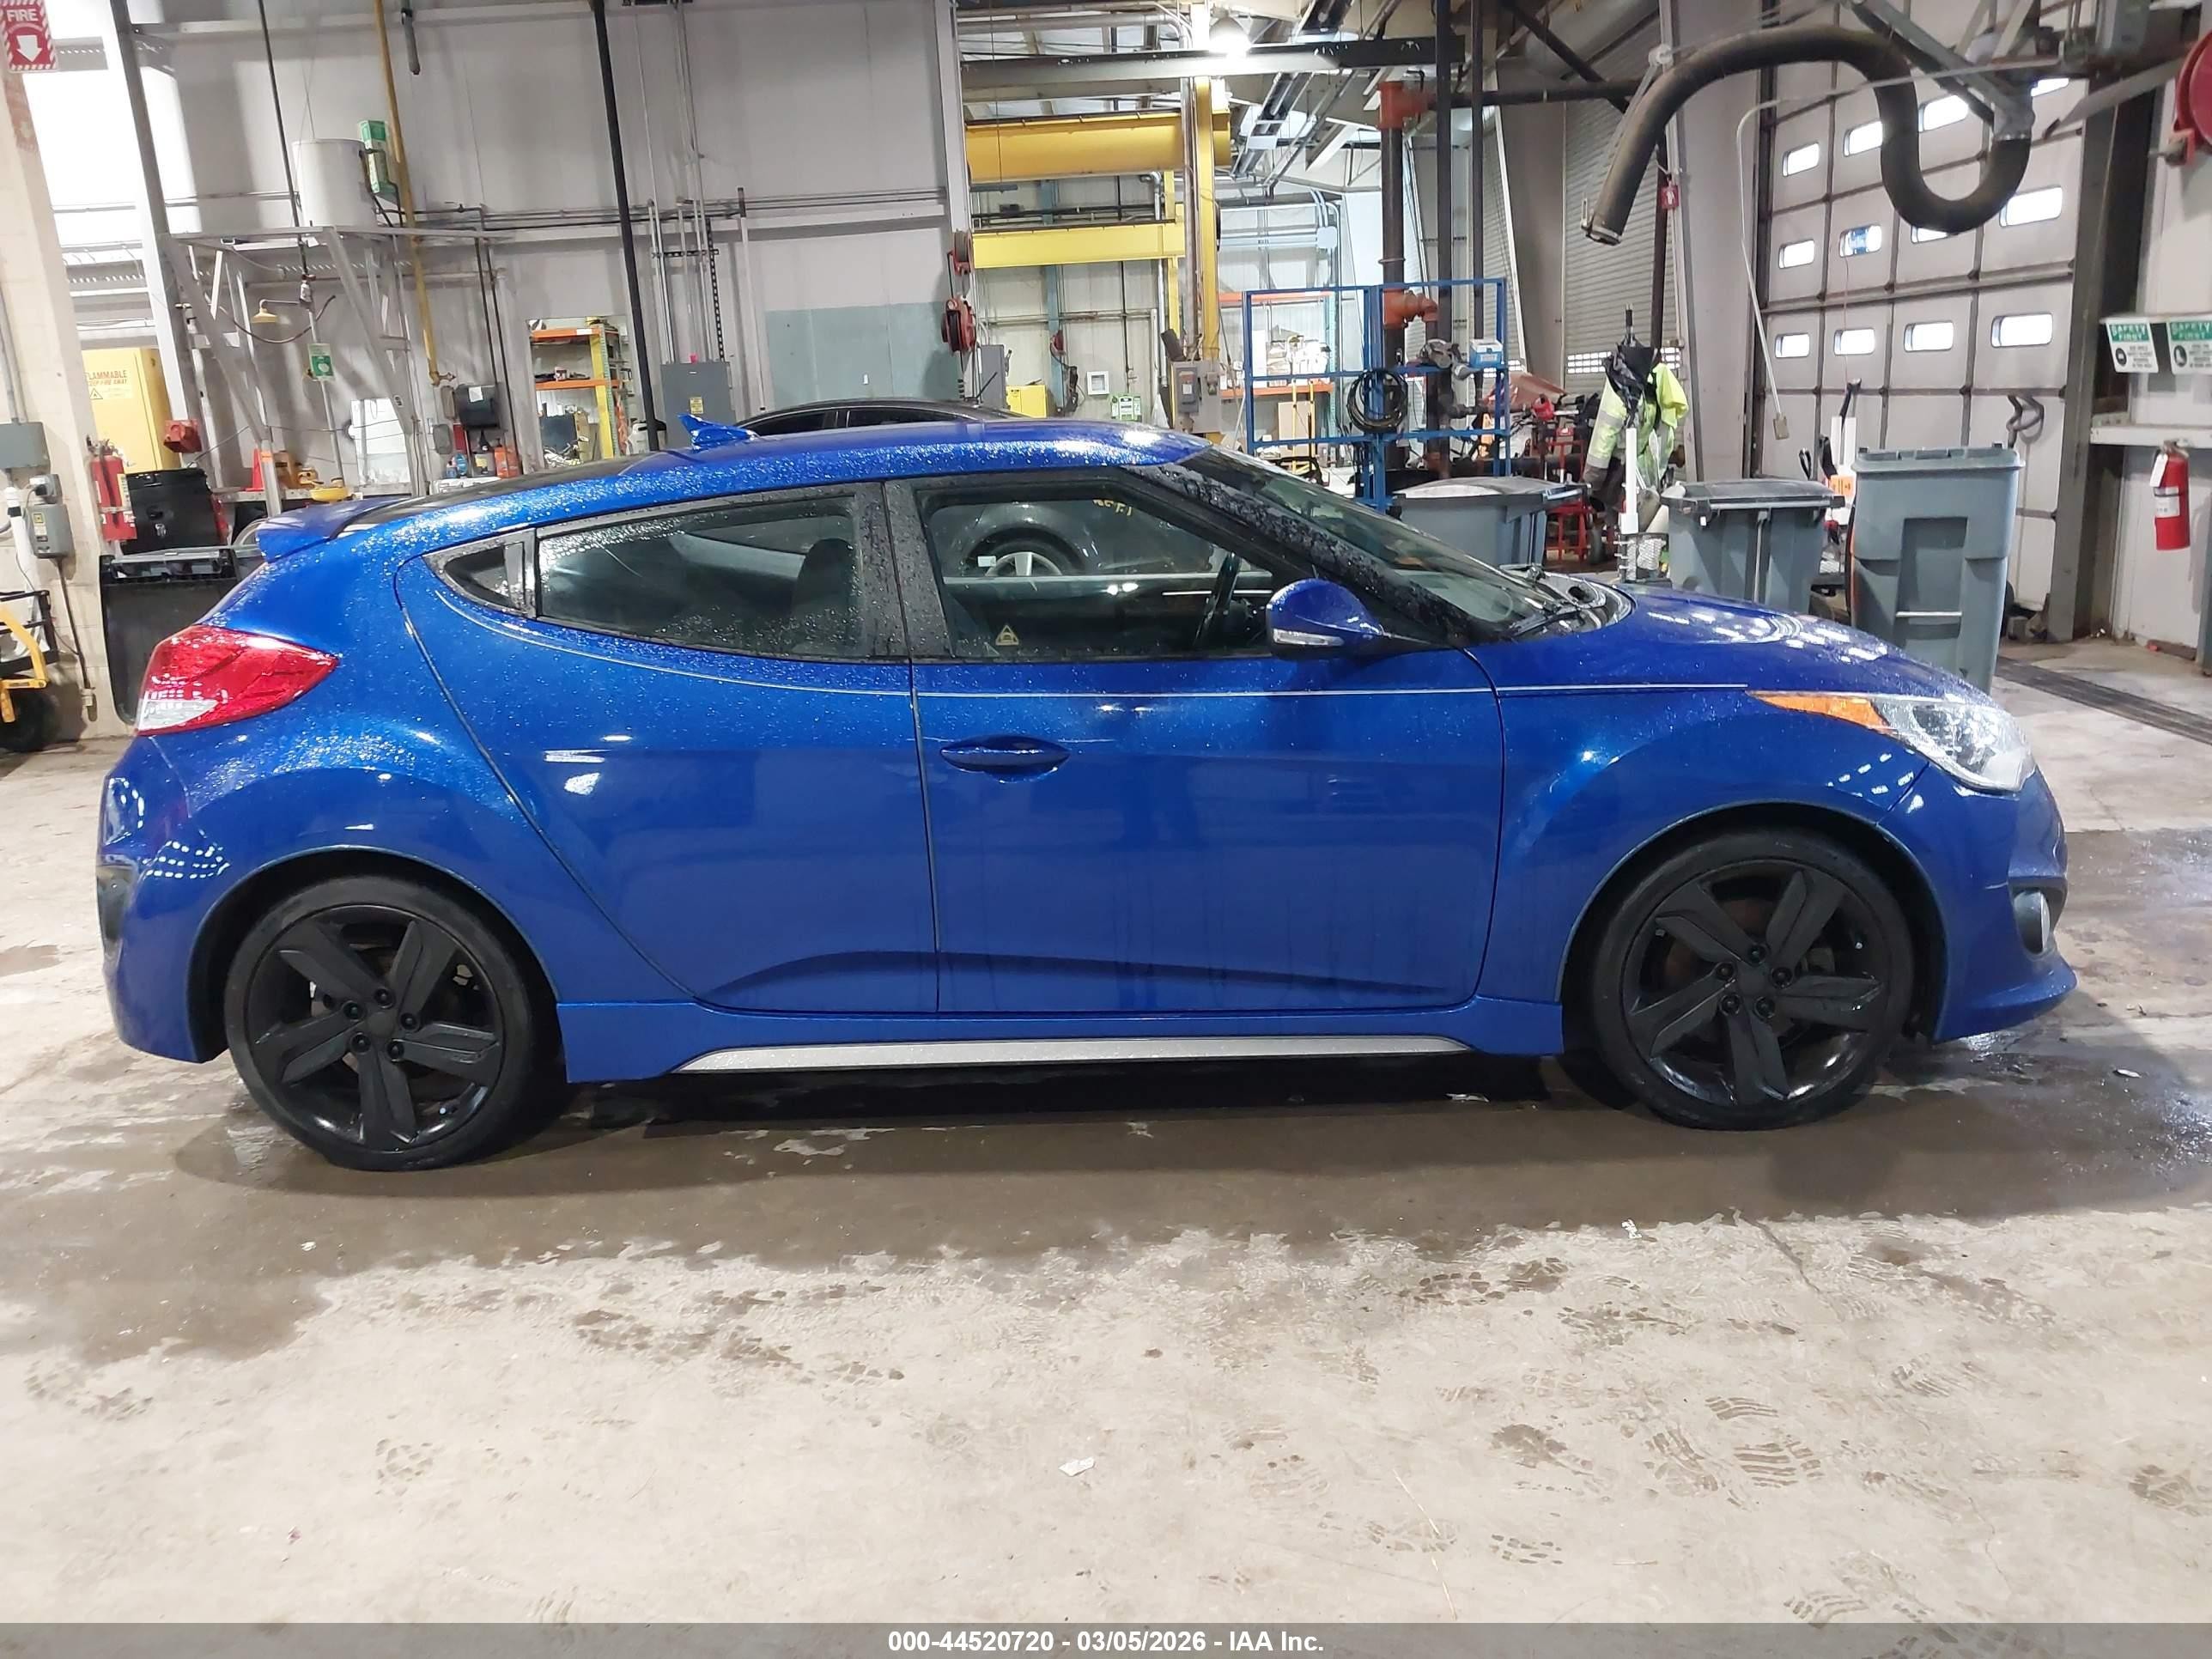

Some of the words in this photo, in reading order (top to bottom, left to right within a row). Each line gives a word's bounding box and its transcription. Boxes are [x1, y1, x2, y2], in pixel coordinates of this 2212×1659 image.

[6, 9, 39, 22] FIRE
[2111, 324, 2147, 337] SAFETY
[2171, 321, 2211, 336] SAFETY
